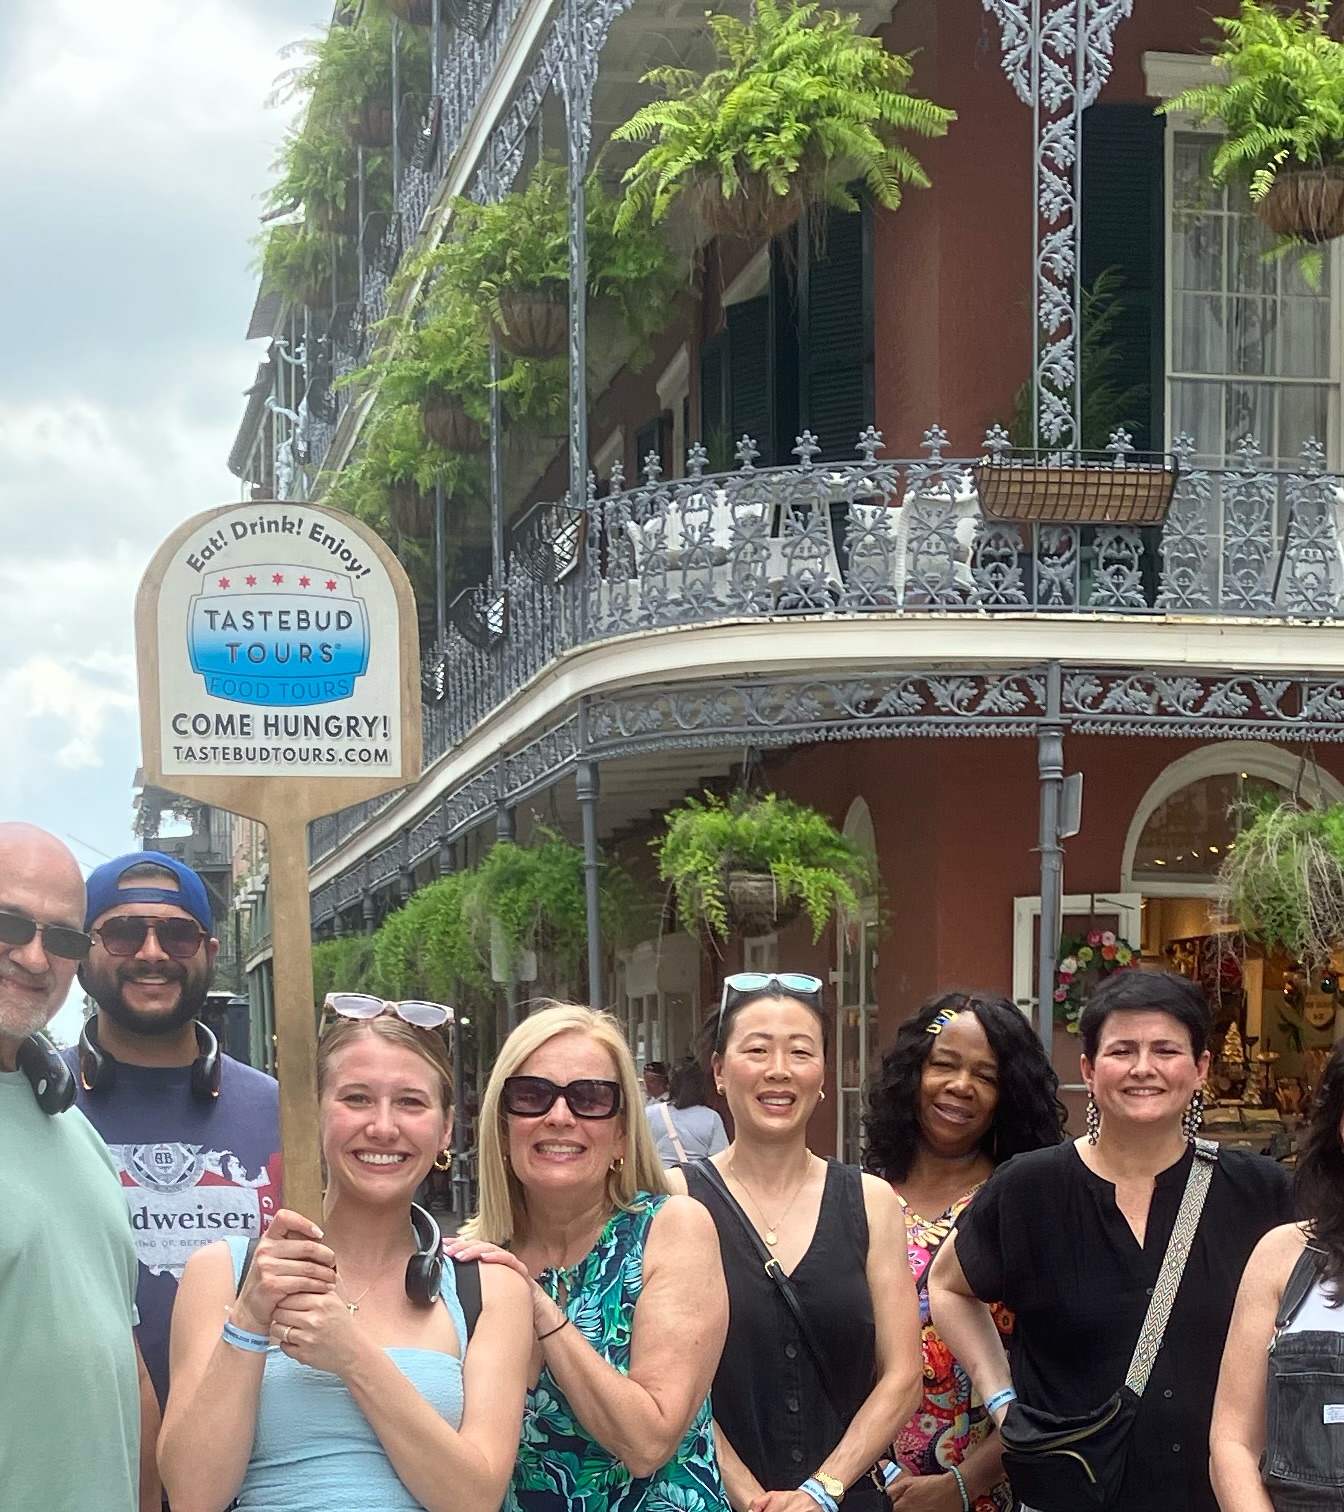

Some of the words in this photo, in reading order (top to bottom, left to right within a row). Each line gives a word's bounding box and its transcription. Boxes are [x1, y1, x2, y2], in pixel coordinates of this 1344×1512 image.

[186, 530, 228, 573] Eat!
[230, 515, 304, 541] Drink!
[308, 523, 371, 580] Enjoy!
[204, 609, 353, 632] TASTEBUD
[226, 642, 334, 664] TOURS
[210, 677, 270, 699] FOOD
[280, 679, 350, 700] TOURS
[172, 713, 254, 737] COME
[264, 714, 391, 739] HUNGRY!
[173, 745, 390, 765] TASTEBUDTOURS.COM
[131, 1204, 256, 1230] dweiser
